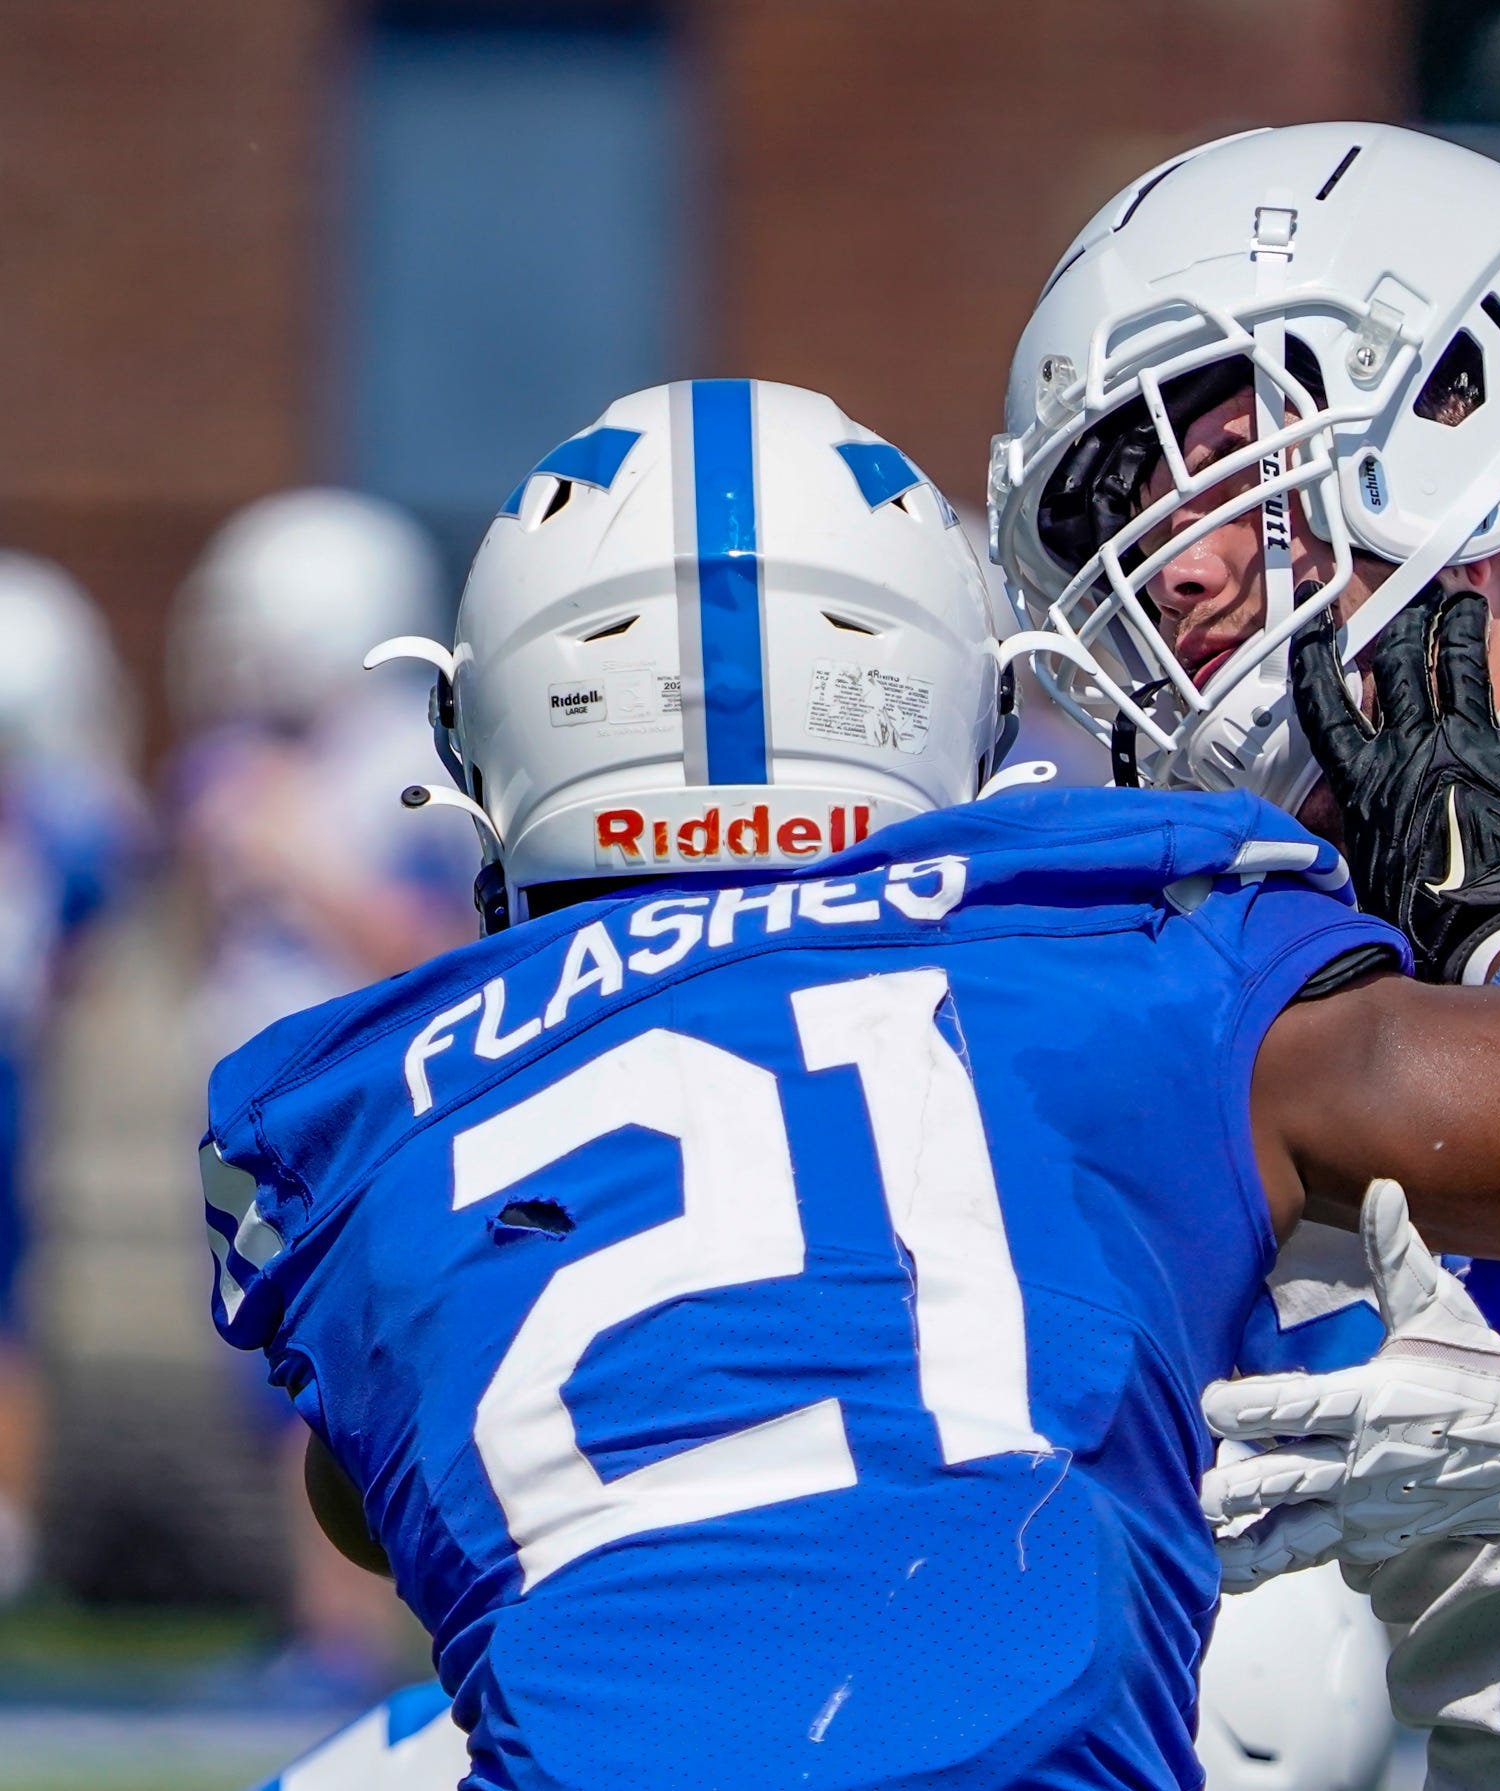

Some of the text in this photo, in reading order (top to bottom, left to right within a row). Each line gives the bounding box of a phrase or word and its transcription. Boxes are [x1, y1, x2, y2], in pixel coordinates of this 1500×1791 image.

[551, 690, 598, 708] Riddell
[565, 705, 588, 716] LARGE
[595, 804, 871, 866] Riddell
[405, 854, 972, 1117] FLASHES
[452, 966, 1052, 1594] 21
